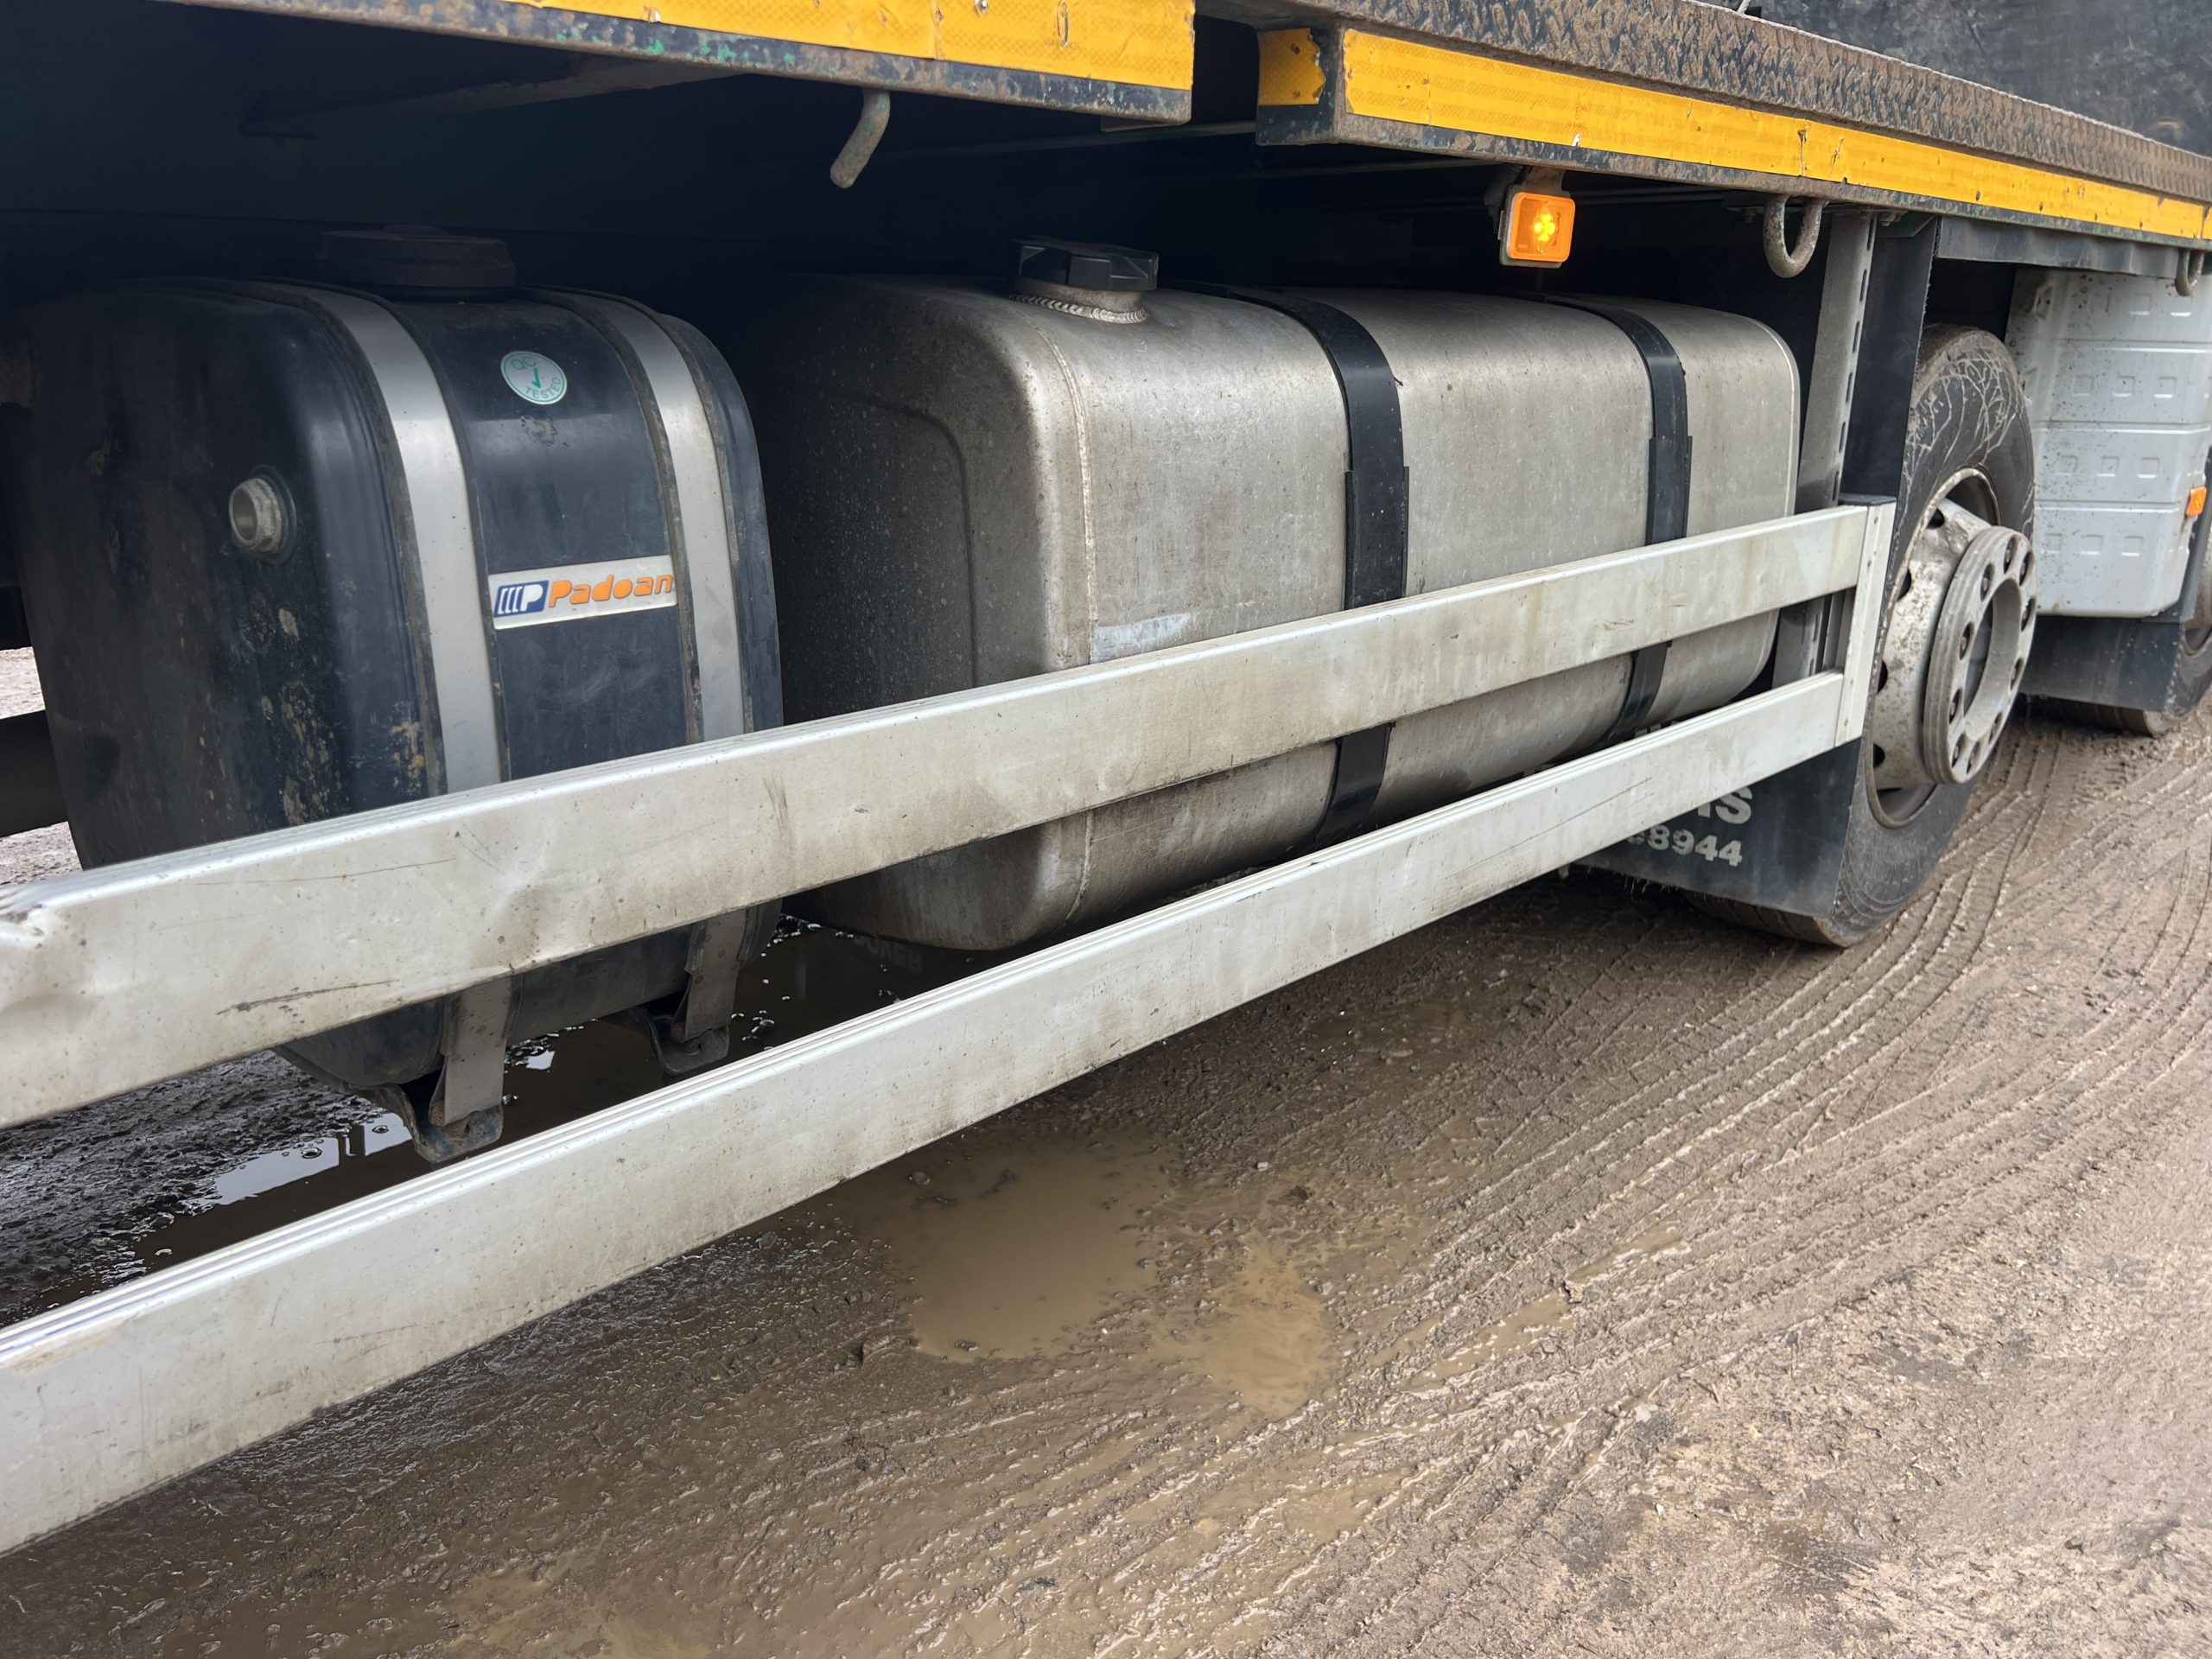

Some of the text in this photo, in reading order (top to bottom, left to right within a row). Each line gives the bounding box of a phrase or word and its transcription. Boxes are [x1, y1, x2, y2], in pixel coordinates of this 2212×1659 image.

[511, 356, 537, 370] QC
[525, 378, 562, 399] TESTED
[549, 574, 674, 608] Padoan
